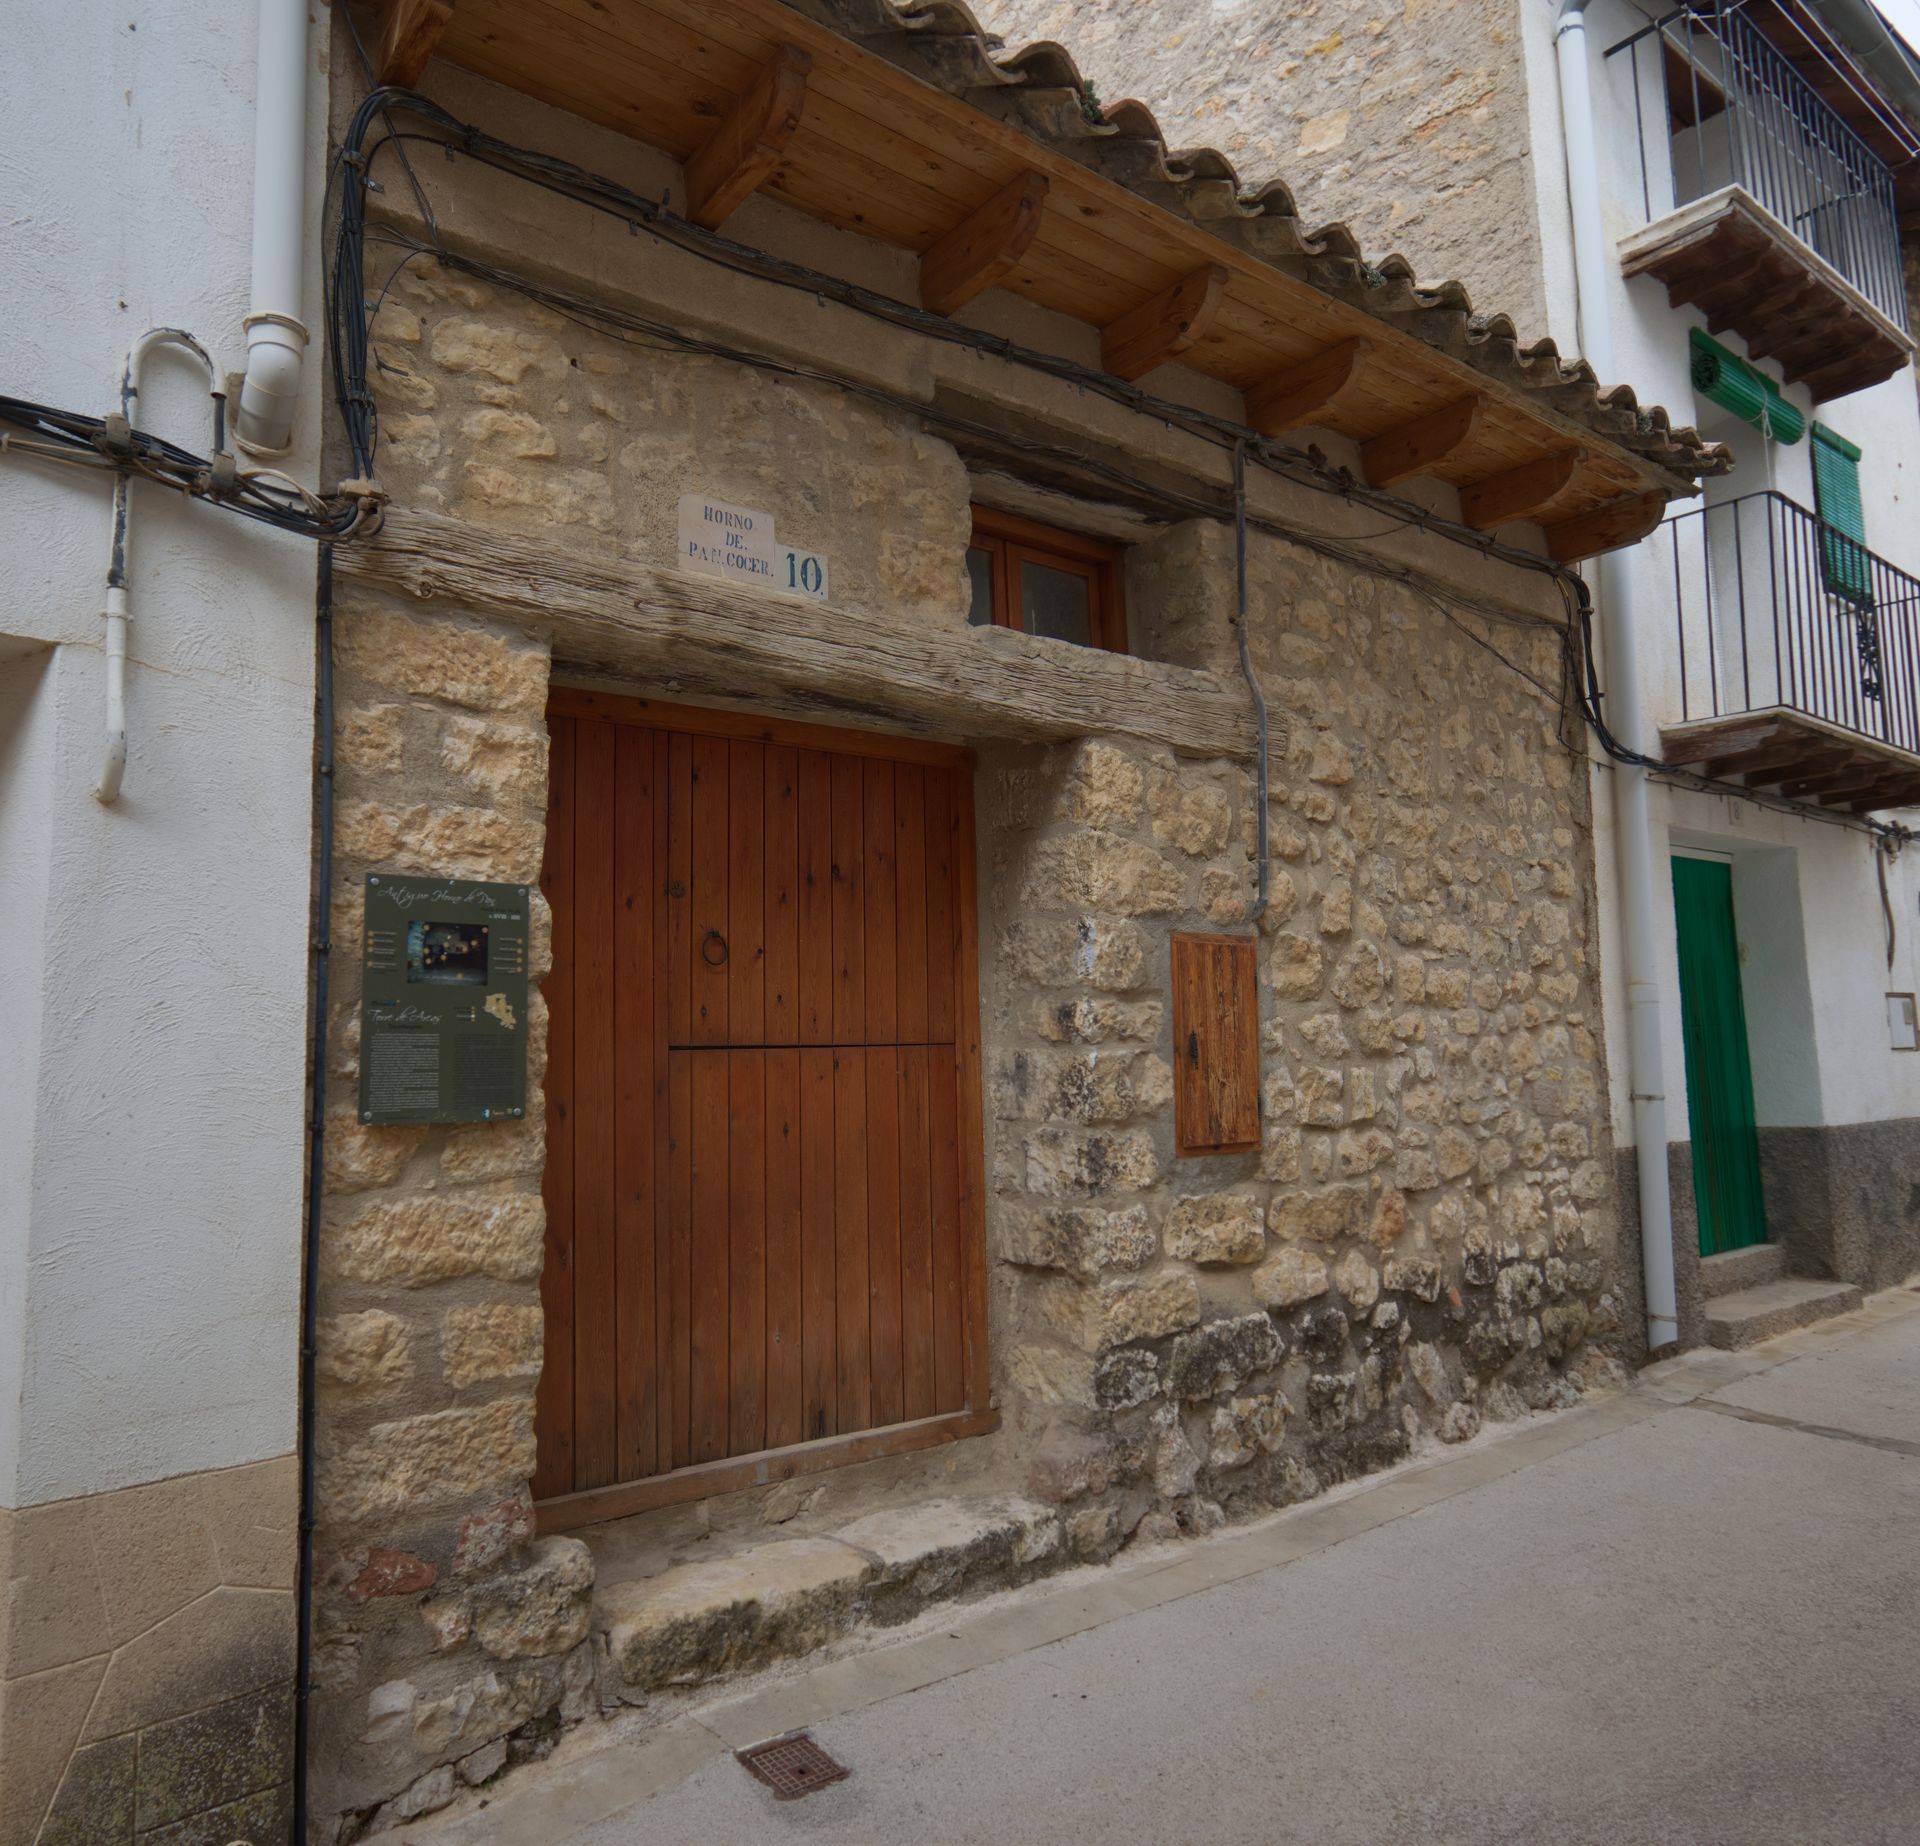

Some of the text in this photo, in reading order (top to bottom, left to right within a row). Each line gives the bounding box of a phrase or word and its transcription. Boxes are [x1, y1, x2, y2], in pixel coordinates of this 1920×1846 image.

[704, 505, 753, 531] HORNO
[430, 889, 463, 905] Horno
[367, 1009, 394, 1023] Torre
